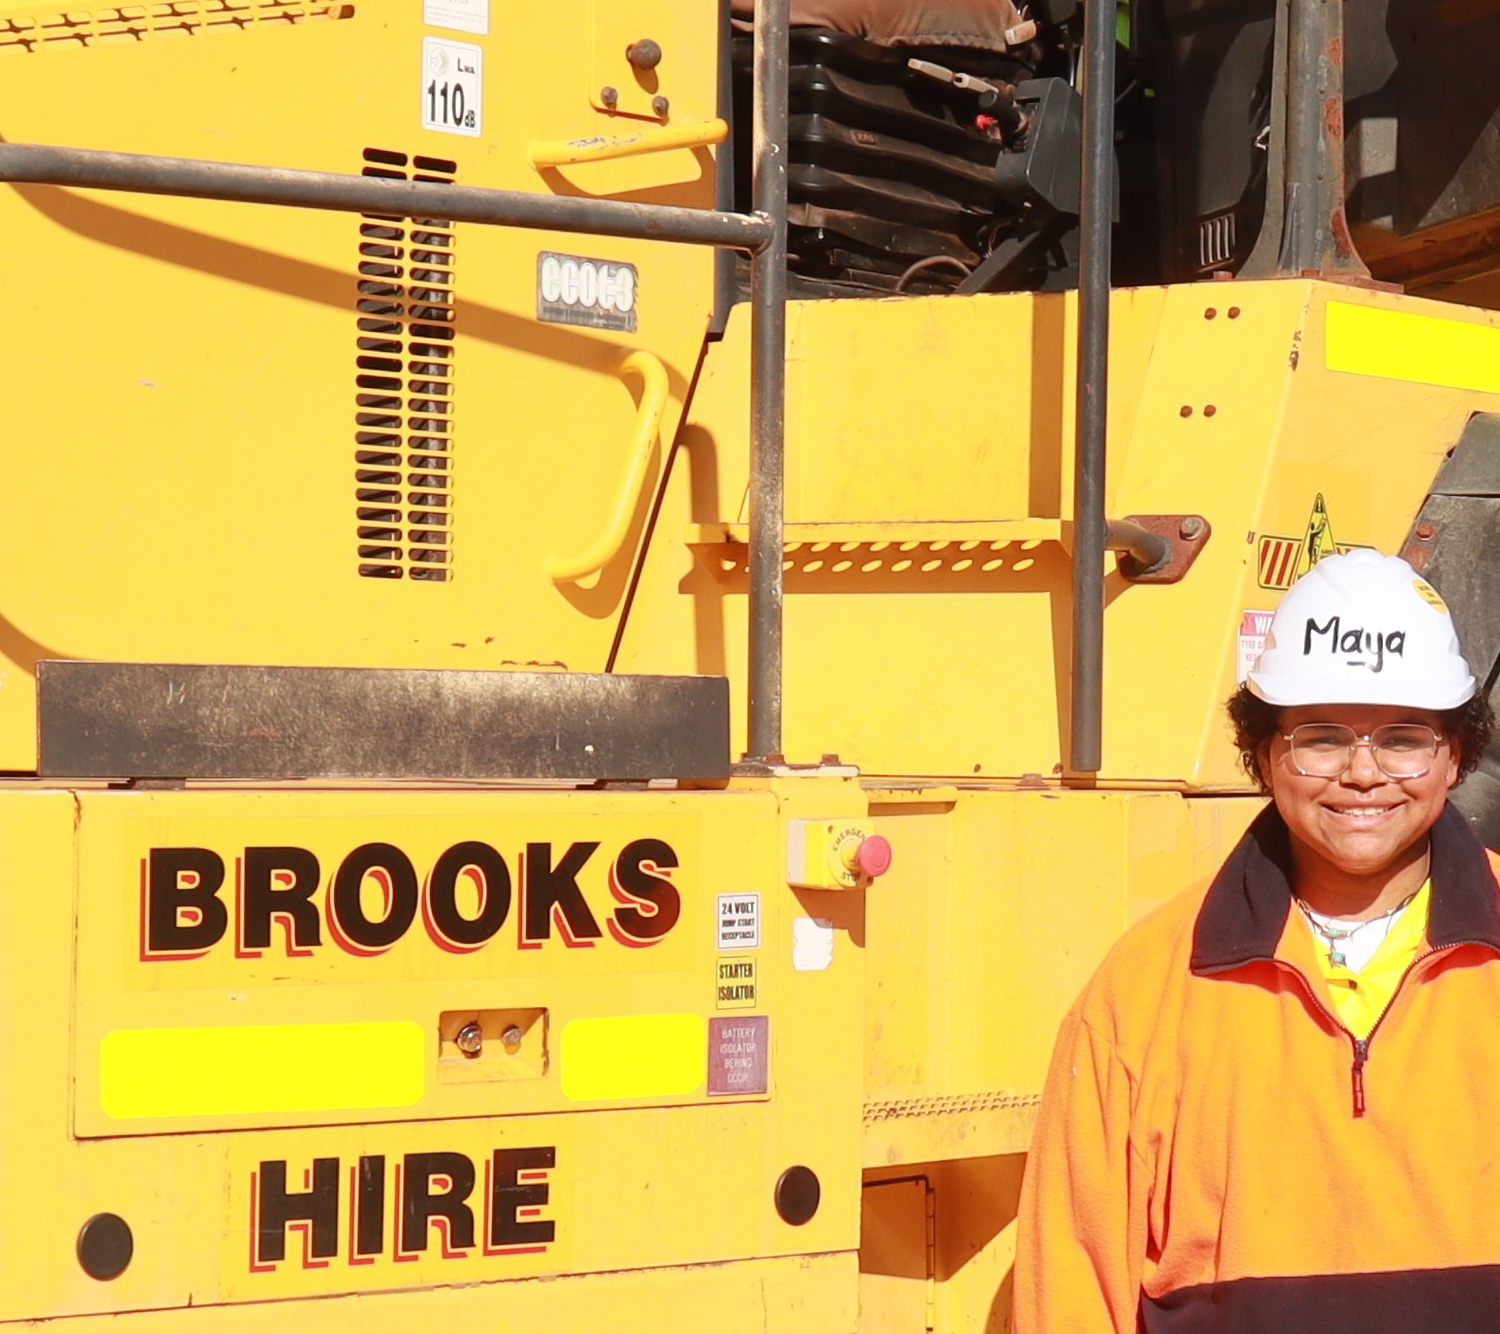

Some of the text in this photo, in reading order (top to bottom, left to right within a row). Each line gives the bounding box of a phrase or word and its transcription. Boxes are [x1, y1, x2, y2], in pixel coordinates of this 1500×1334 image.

[1303, 616, 1406, 673] Maya
[139, 838, 681, 962] BROOKS
[722, 902, 755, 915] 24 VOLT
[719, 963, 753, 979] STARTER
[718, 985, 755, 1001] ISOLATOR
[722, 1027, 756, 1039] BATTERY
[720, 1042, 756, 1054] ISOLATOR
[724, 1057, 752, 1069] BEHIND
[248, 1146, 556, 1273] HIRE
